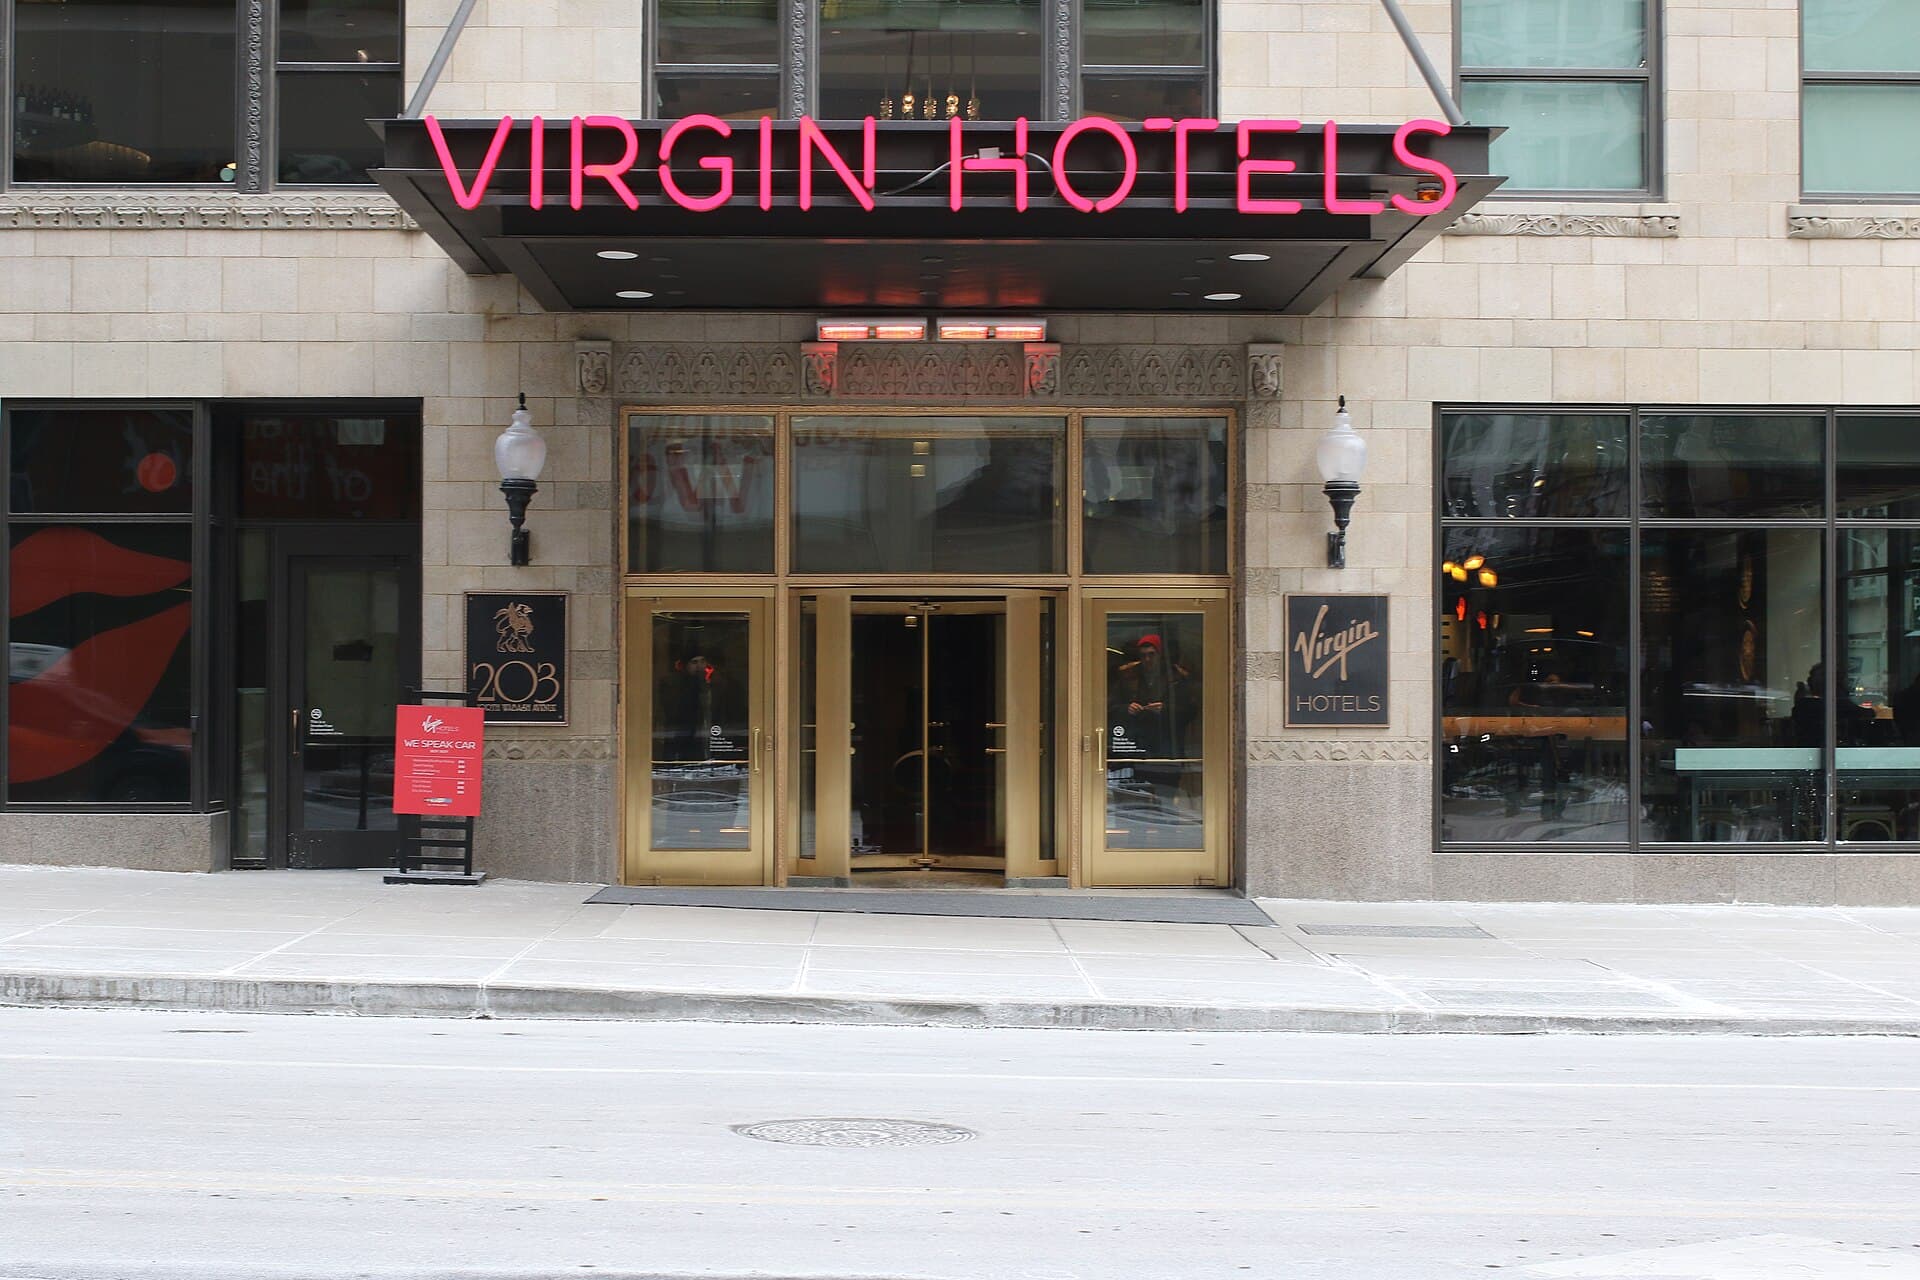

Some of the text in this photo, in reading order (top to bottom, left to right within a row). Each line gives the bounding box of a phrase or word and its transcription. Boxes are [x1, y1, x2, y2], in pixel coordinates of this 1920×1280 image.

[425, 114, 1457, 216] VIRGIN HOTELS
[1293, 604, 1379, 681] Virgin
[472, 660, 561, 704] 203
[1296, 695, 1381, 712] HOTELS
[404, 739, 476, 750] WE SPEAK CAR
